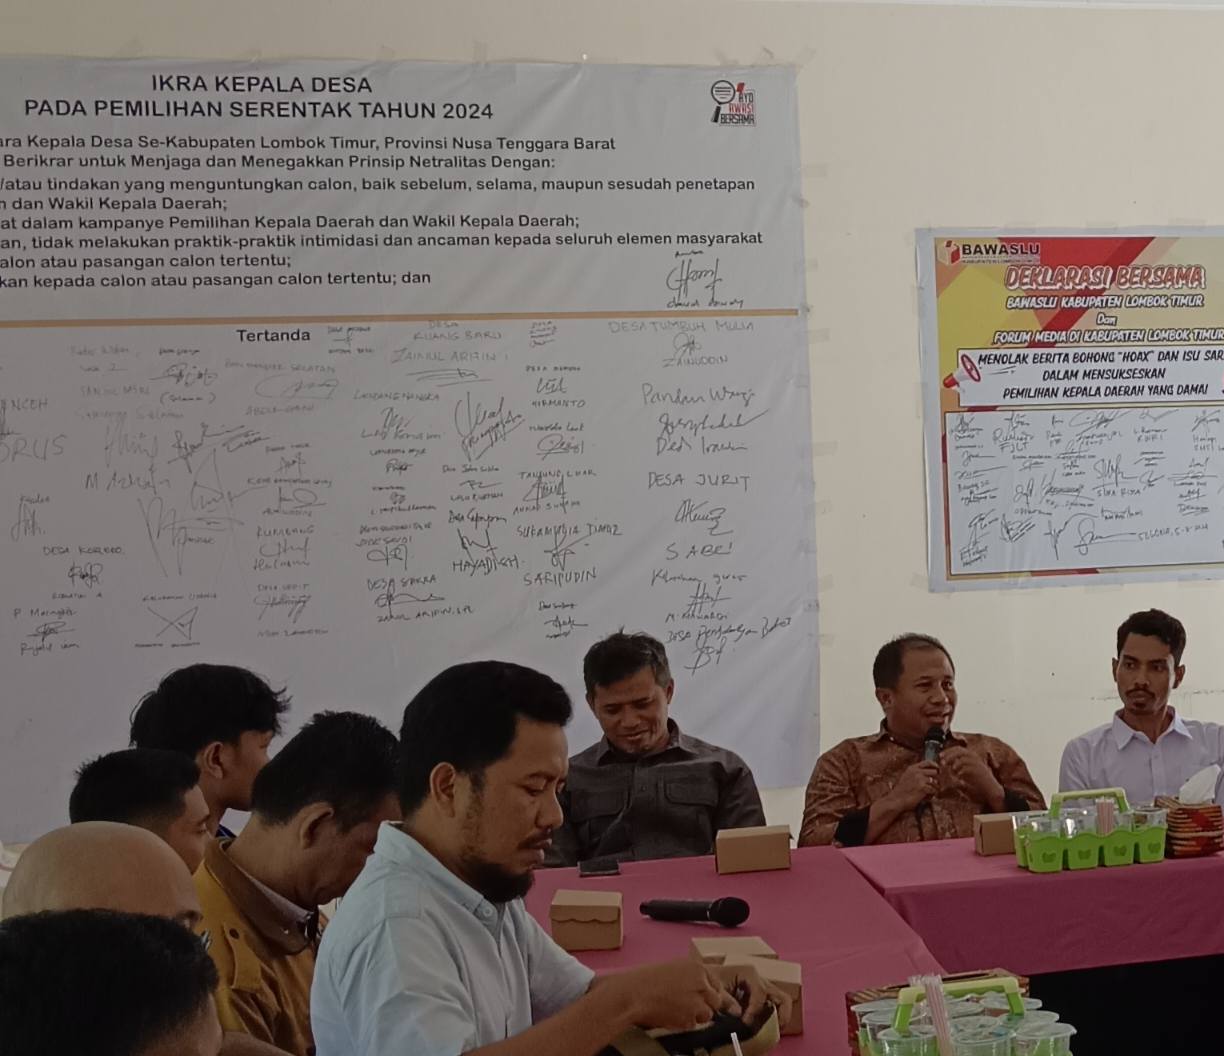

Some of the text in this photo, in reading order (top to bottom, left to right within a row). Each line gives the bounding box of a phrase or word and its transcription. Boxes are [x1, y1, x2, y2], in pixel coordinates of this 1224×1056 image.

[151, 74, 373, 94] IKRA KEPALA DESA
[24, 98, 494, 120] PADA PEMILIHAN SERENTAK TAHUN 2024
[720, 113, 755, 124] BERSAMA
[27, 134, 86, 151] Kepala
[90, 134, 133, 149] Desa
[137, 135, 256, 151] Se-Kabupaten
[260, 135, 326, 149] Lombok
[329, 136, 380, 152] Timur,
[384, 136, 448, 150] Provinsi
[452, 136, 493, 150] Nusa
[495, 136, 569, 153] Tenggara
[573, 136, 617, 151] Barat
[3, 153, 556, 172] Berikrar untuk Menjaga dan Menegakkan Prinsip Netralitas Dengan:
[47, 177, 120, 191] tindakan
[124, 180, 165, 194] yang
[169, 177, 303, 194] menguntungkan
[307, 176, 358, 193] calon,
[361, 177, 396, 191] baik
[400, 177, 472, 192] sebelum,
[476, 177, 537, 193] selama,
[541, 180, 604, 193] maupun
[607, 177, 672, 191] sesudah
[675, 177, 755, 194] penetapan
[11, 197, 44, 210] dan
[48, 196, 94, 210] Wakil
[98, 196, 157, 213] Kepala
[161, 196, 228, 212] Daerah;
[21, 216, 74, 230] dalam
[78, 216, 165, 232] kampanye
[169, 215, 250, 229] Pemilihan
[254, 215, 312, 232] Kepala
[315, 215, 375, 228] Daerah
[378, 215, 409, 228] dan
[412, 214, 456, 228] Wakil
[459, 214, 515, 231] Kepala
[518, 214, 580, 229] Daerah;
[31, 235, 75, 249] tidak
[78, 235, 170, 249] melakukan
[174, 234, 297, 251] praktik-praktik
[300, 233, 379, 248] intimidasi
[382, 233, 413, 247] dan
[417, 236, 490, 247] ancaman
[494, 232, 552, 249] kepada
[555, 232, 613, 246] seluruh
[616, 231, 672, 245] elemen
[676, 231, 764, 248] masyarakat
[962, 244, 1039, 255] BAWASLU
[40, 255, 78, 269] atau
[82, 257, 165, 271] pasangan
[169, 253, 215, 268] calon
[220, 253, 292, 268] tertentu;
[33, 274, 96, 291] kepada
[100, 273, 146, 288] calon
[150, 273, 188, 287] atau
[192, 275, 273, 289] pasangan
[277, 272, 323, 286] calon
[327, 271, 397, 287] tertentu;
[400, 271, 431, 284] dan
[1005, 264, 1206, 290] DEKLARASI BERSAMA
[1006, 294, 1204, 309] BAWASLU KABUPATEN LOMBOK TIMUR
[1096, 312, 1117, 326] Dan
[235, 327, 311, 343] Tertanda
[994, 330, 1033, 343] FORUM
[1034, 330, 1067, 343] MEDIA
[1069, 329, 1081, 342] DI
[1083, 329, 1146, 343] KABUPATEN
[1147, 328, 1191, 342] LOMBOK
[978, 353, 1029, 365] MENOLAK
[1032, 352, 1070, 364] BERITA
[1072, 351, 1115, 363] BOHONG
[1157, 350, 1180, 362] DAN
[1182, 350, 1201, 362] ISU
[1042, 367, 1167, 382] DALAM MENSUKSESKAN
[1002, 383, 1209, 400] PEMILIHAN KEPALA DAERAH YANG DAMAI
